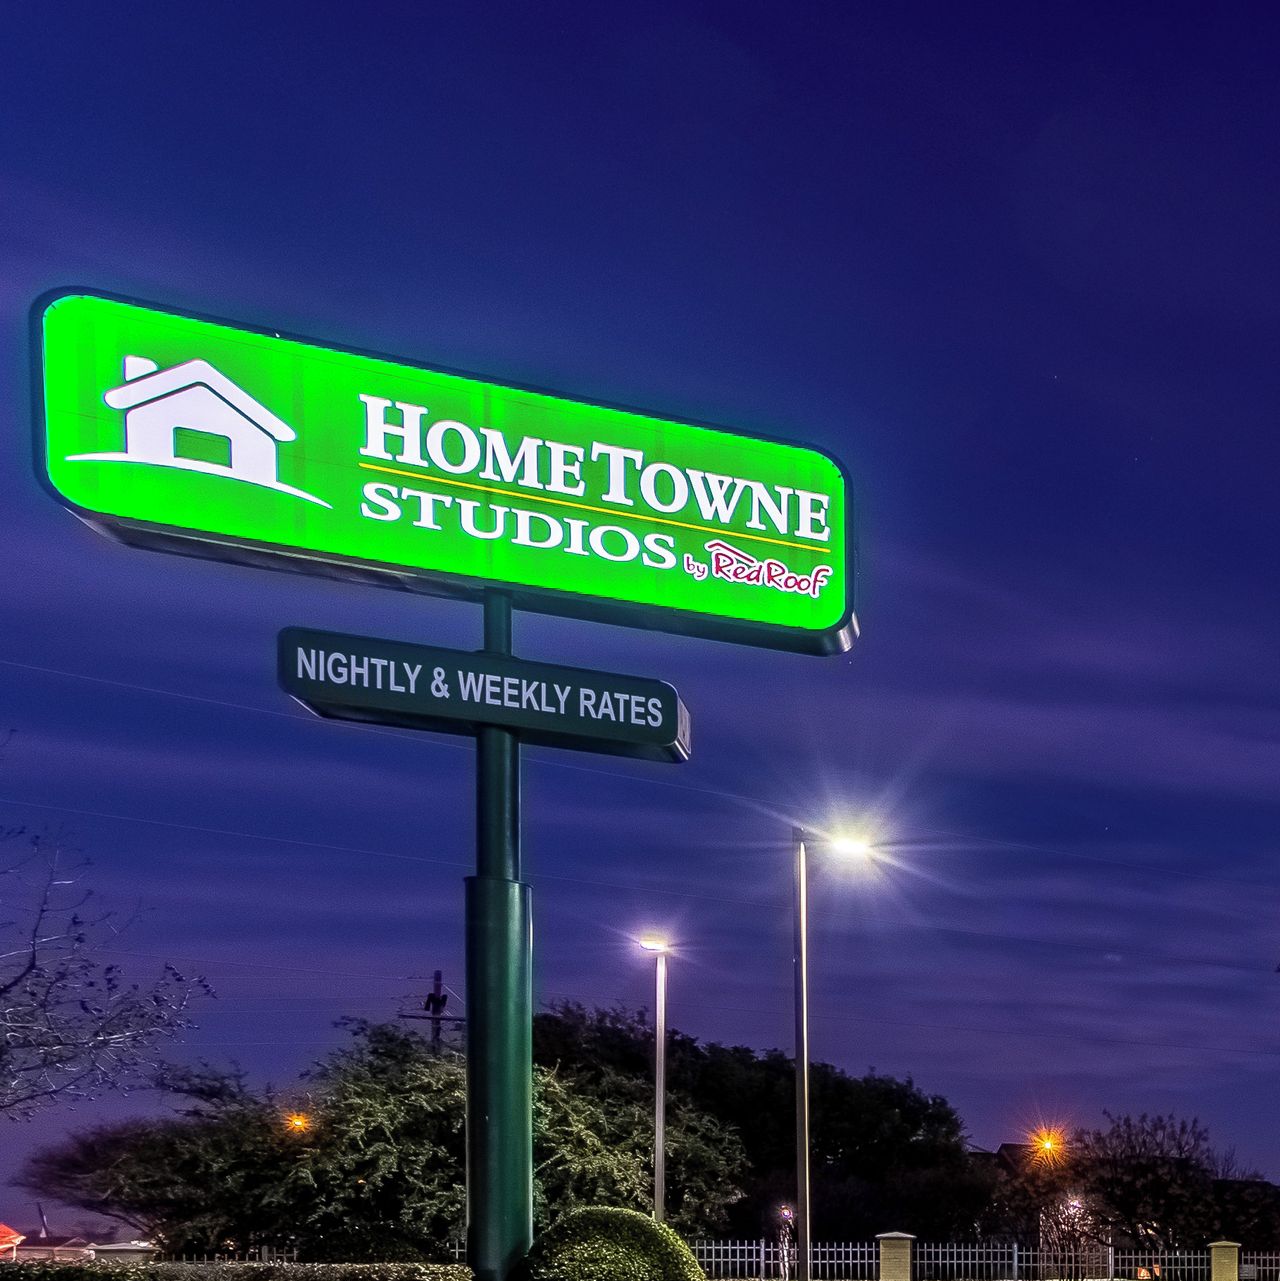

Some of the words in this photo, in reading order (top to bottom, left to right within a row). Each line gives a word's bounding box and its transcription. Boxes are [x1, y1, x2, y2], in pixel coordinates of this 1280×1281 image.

[360, 482, 677, 570] STUDIOS
[684, 553, 708, 581] by
[297, 647, 422, 694] NIGHTLY
[430, 666, 450, 699] &
[457, 670, 571, 715] WEEKLY
[579, 688, 663, 728] RATES
